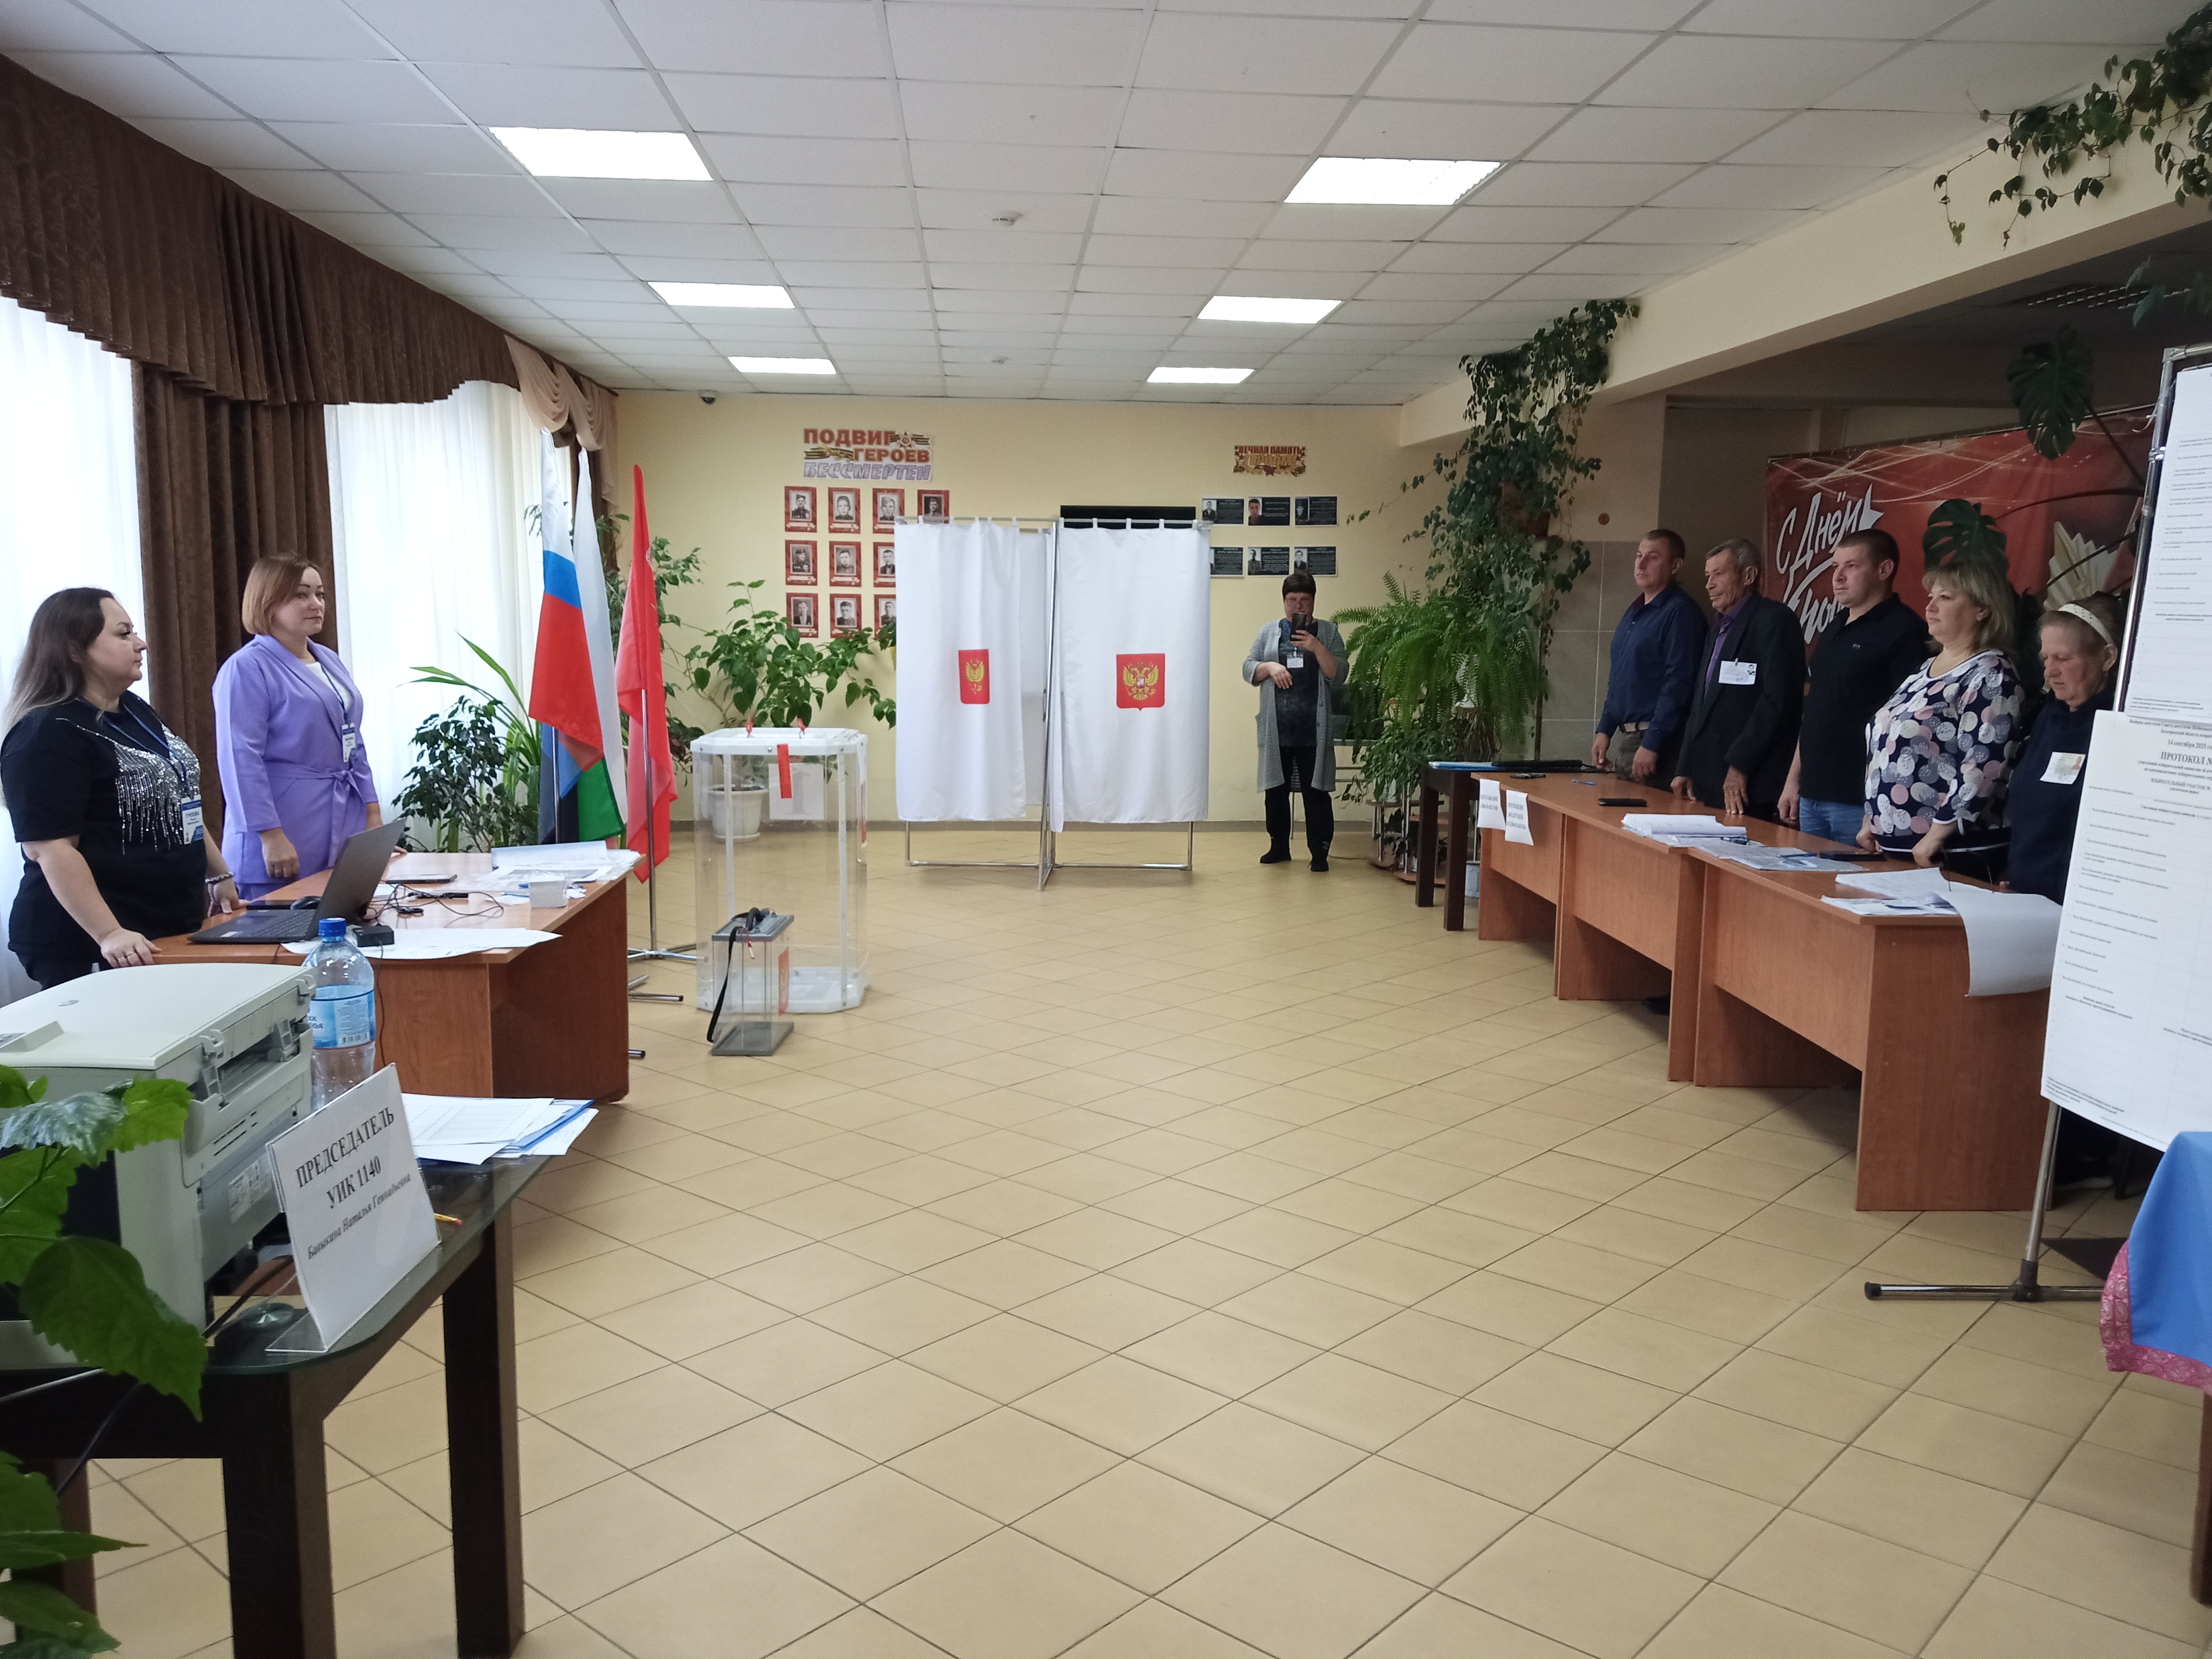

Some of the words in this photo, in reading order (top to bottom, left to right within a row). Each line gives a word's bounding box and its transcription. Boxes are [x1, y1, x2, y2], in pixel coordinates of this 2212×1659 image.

[804, 428, 895, 446] ПОДВИГ
[854, 448, 930, 463] ГЕРОЕВ
[1239, 445, 1269, 454] ВЕЧНАЯ
[1271, 446, 1302, 455] ПАМЯТЬ
[804, 462, 931, 480] БЕССМЕРТЕН
[1776, 507, 1797, 574] С
[1783, 483, 1884, 603] Днём
[2161, 751, 2205, 765] ПРОТОКОЛ
[295, 1106, 395, 1188] ПРЕДСЕДАТЕЛЬ
[326, 1174, 356, 1209] УИК
[357, 1155, 382, 1187] 1140
[343, 1203, 372, 1232] Наталья
